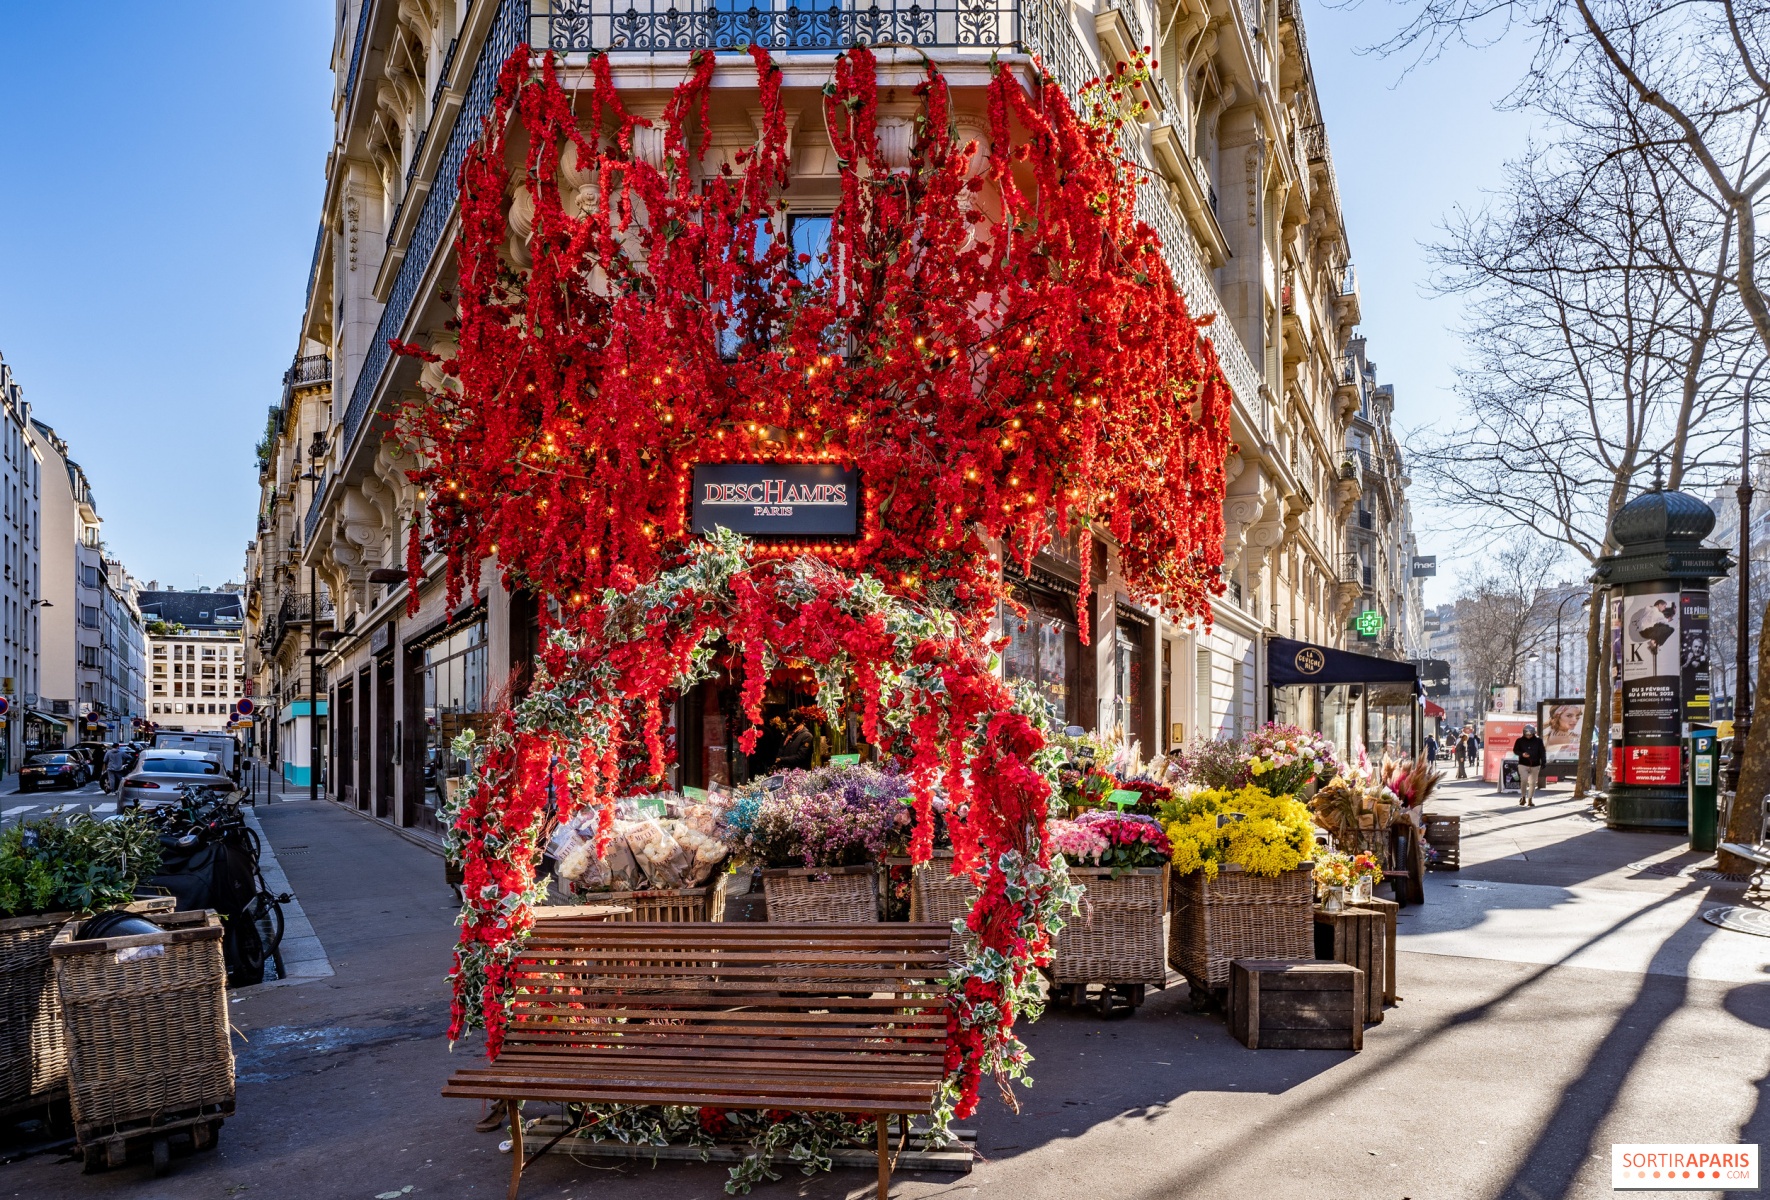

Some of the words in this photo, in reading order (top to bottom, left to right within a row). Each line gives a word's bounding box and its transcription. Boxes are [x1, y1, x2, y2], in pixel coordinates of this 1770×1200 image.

[704, 479, 847, 504] DESCHAMPS
[754, 506, 793, 516] PARIS
[1617, 563, 1654, 573] THEATRES
[1684, 606, 1693, 615] LES
[1630, 643, 1643, 662] K
[1298, 654, 1321, 668] CEVICHE
